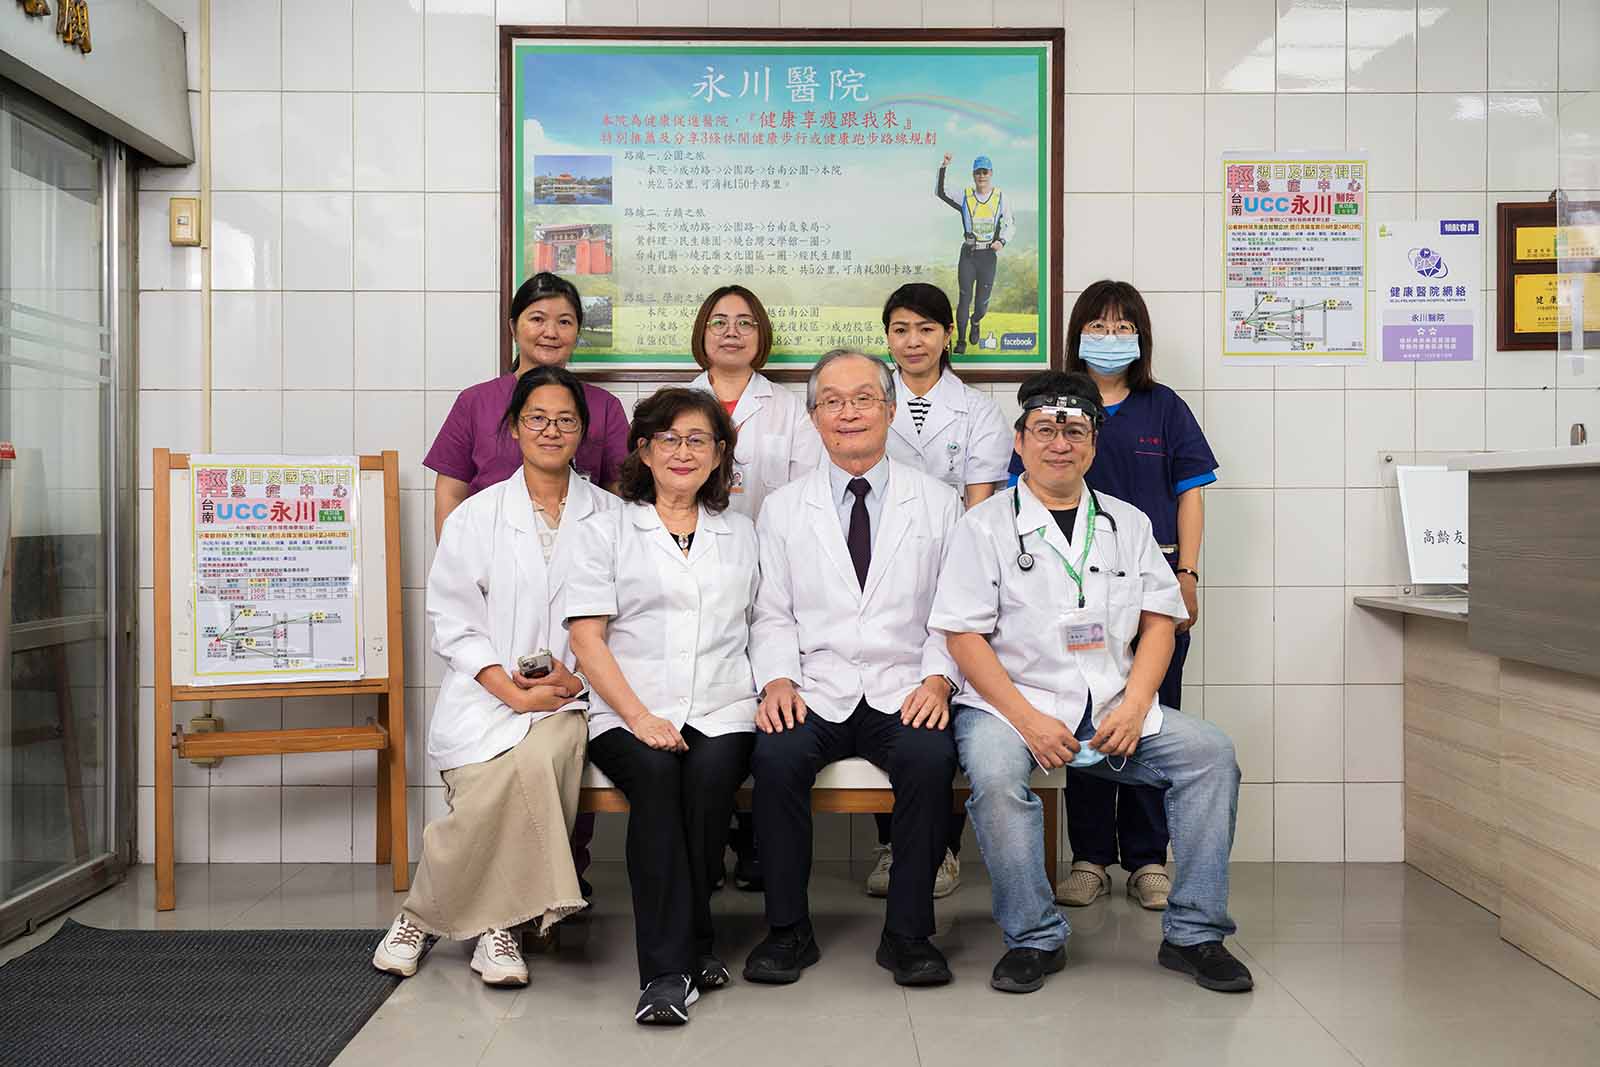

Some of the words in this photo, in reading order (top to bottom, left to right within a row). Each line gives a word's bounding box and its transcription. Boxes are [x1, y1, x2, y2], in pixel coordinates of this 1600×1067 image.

[692, 66, 870, 103] 永川醫院
[1232, 193, 1242, 216] 台南
[1244, 197, 1289, 212] UCC
[1292, 195, 1331, 214] 永川
[1390, 286, 1466, 297] 健康醫院網絡
[1004, 337, 1033, 346] facebook
[202, 499, 214, 523] 台南
[217, 503, 268, 520] UCC
[271, 501, 315, 522] 永川
